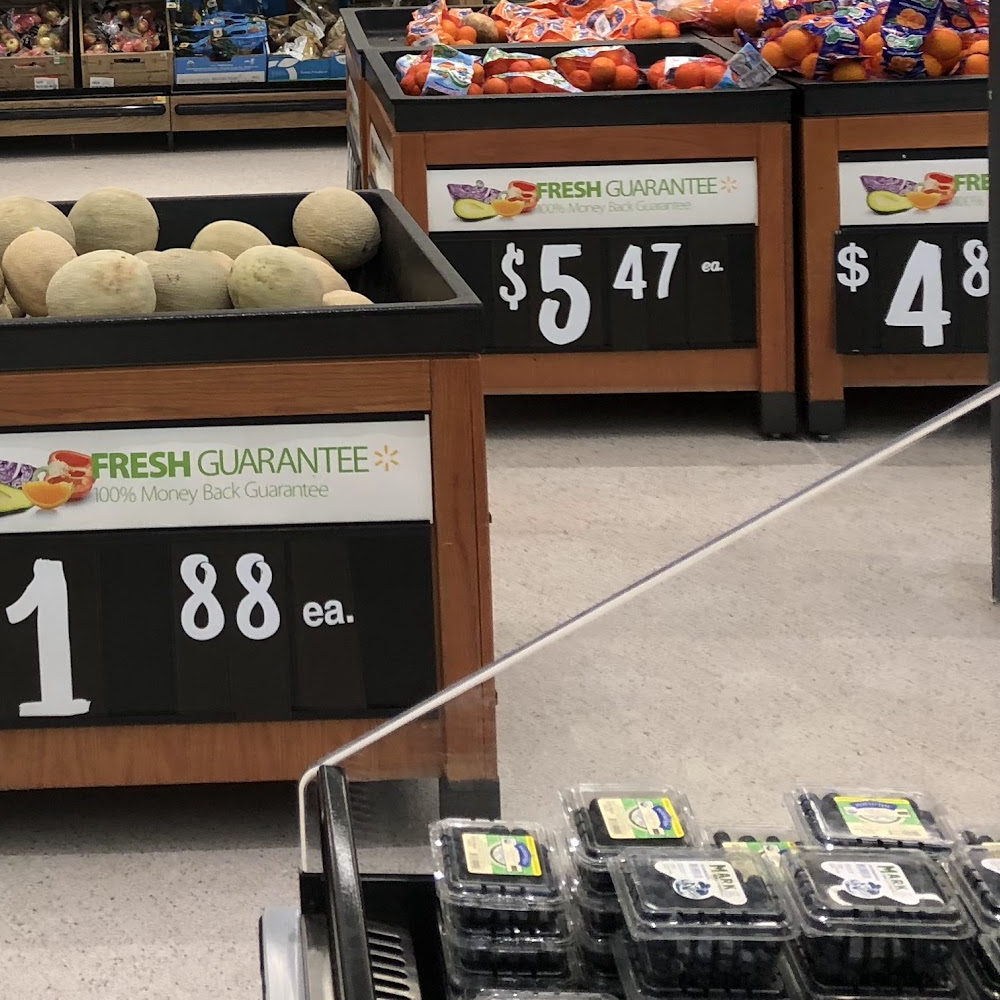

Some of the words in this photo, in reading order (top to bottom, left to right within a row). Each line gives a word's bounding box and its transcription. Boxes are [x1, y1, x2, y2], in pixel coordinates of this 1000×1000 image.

[536, 180, 602, 199] FRESH
[606, 176, 718, 198] GUARANTEE
[568, 202, 605, 216] Money
[608, 200, 633, 212] Back
[636, 200, 691, 212] Guarantee
[700, 259, 724, 273] ea.
[91, 450, 191, 479] FRESH
[197, 446, 369, 477] GUARANTEE
[93, 485, 137, 503] 100%
[141, 484, 198, 505] Money
[203, 482, 241, 501] Back
[244, 481, 329, 499] Guarantee
[302, 600, 356, 628] ea.
